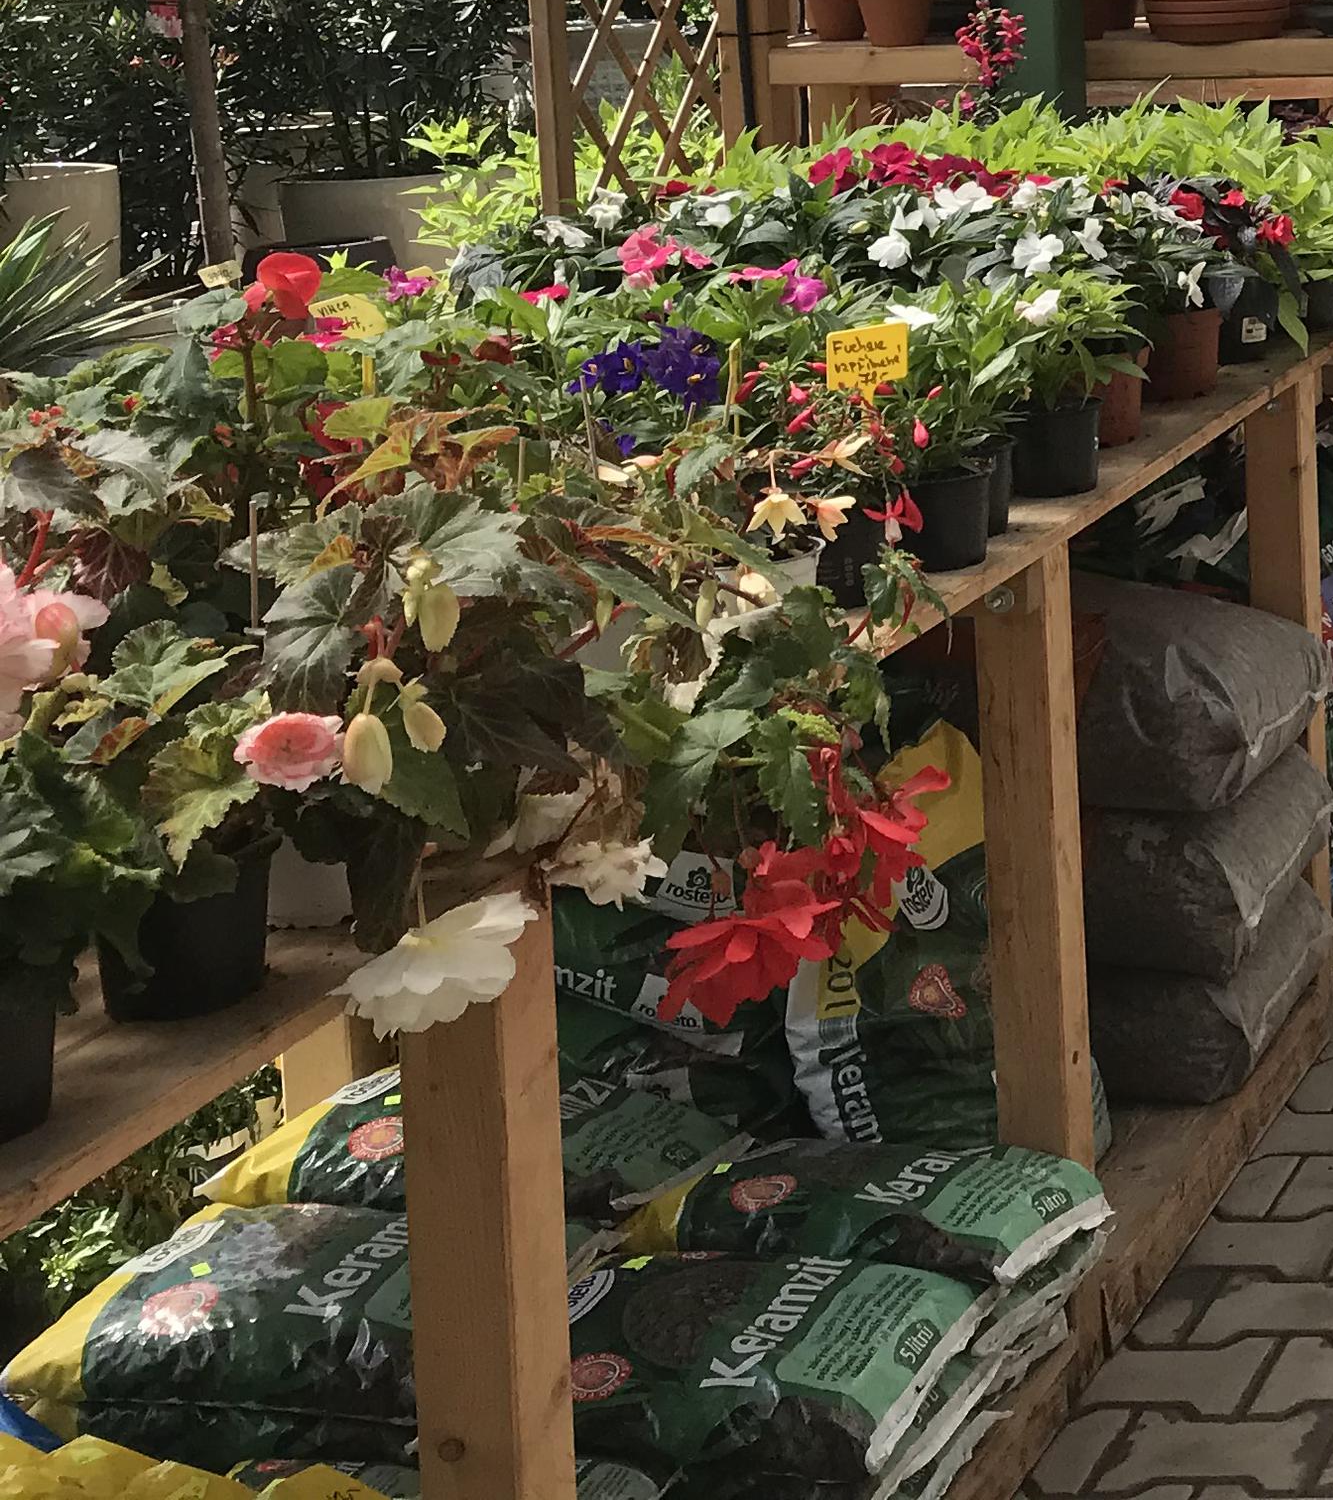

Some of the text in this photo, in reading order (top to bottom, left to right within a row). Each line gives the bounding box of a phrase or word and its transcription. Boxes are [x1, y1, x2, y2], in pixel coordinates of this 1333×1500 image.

[317, 300, 351, 318] VINCA
[699, 1255, 853, 1389] Keramzit
[899, 1348, 917, 1365] 5
